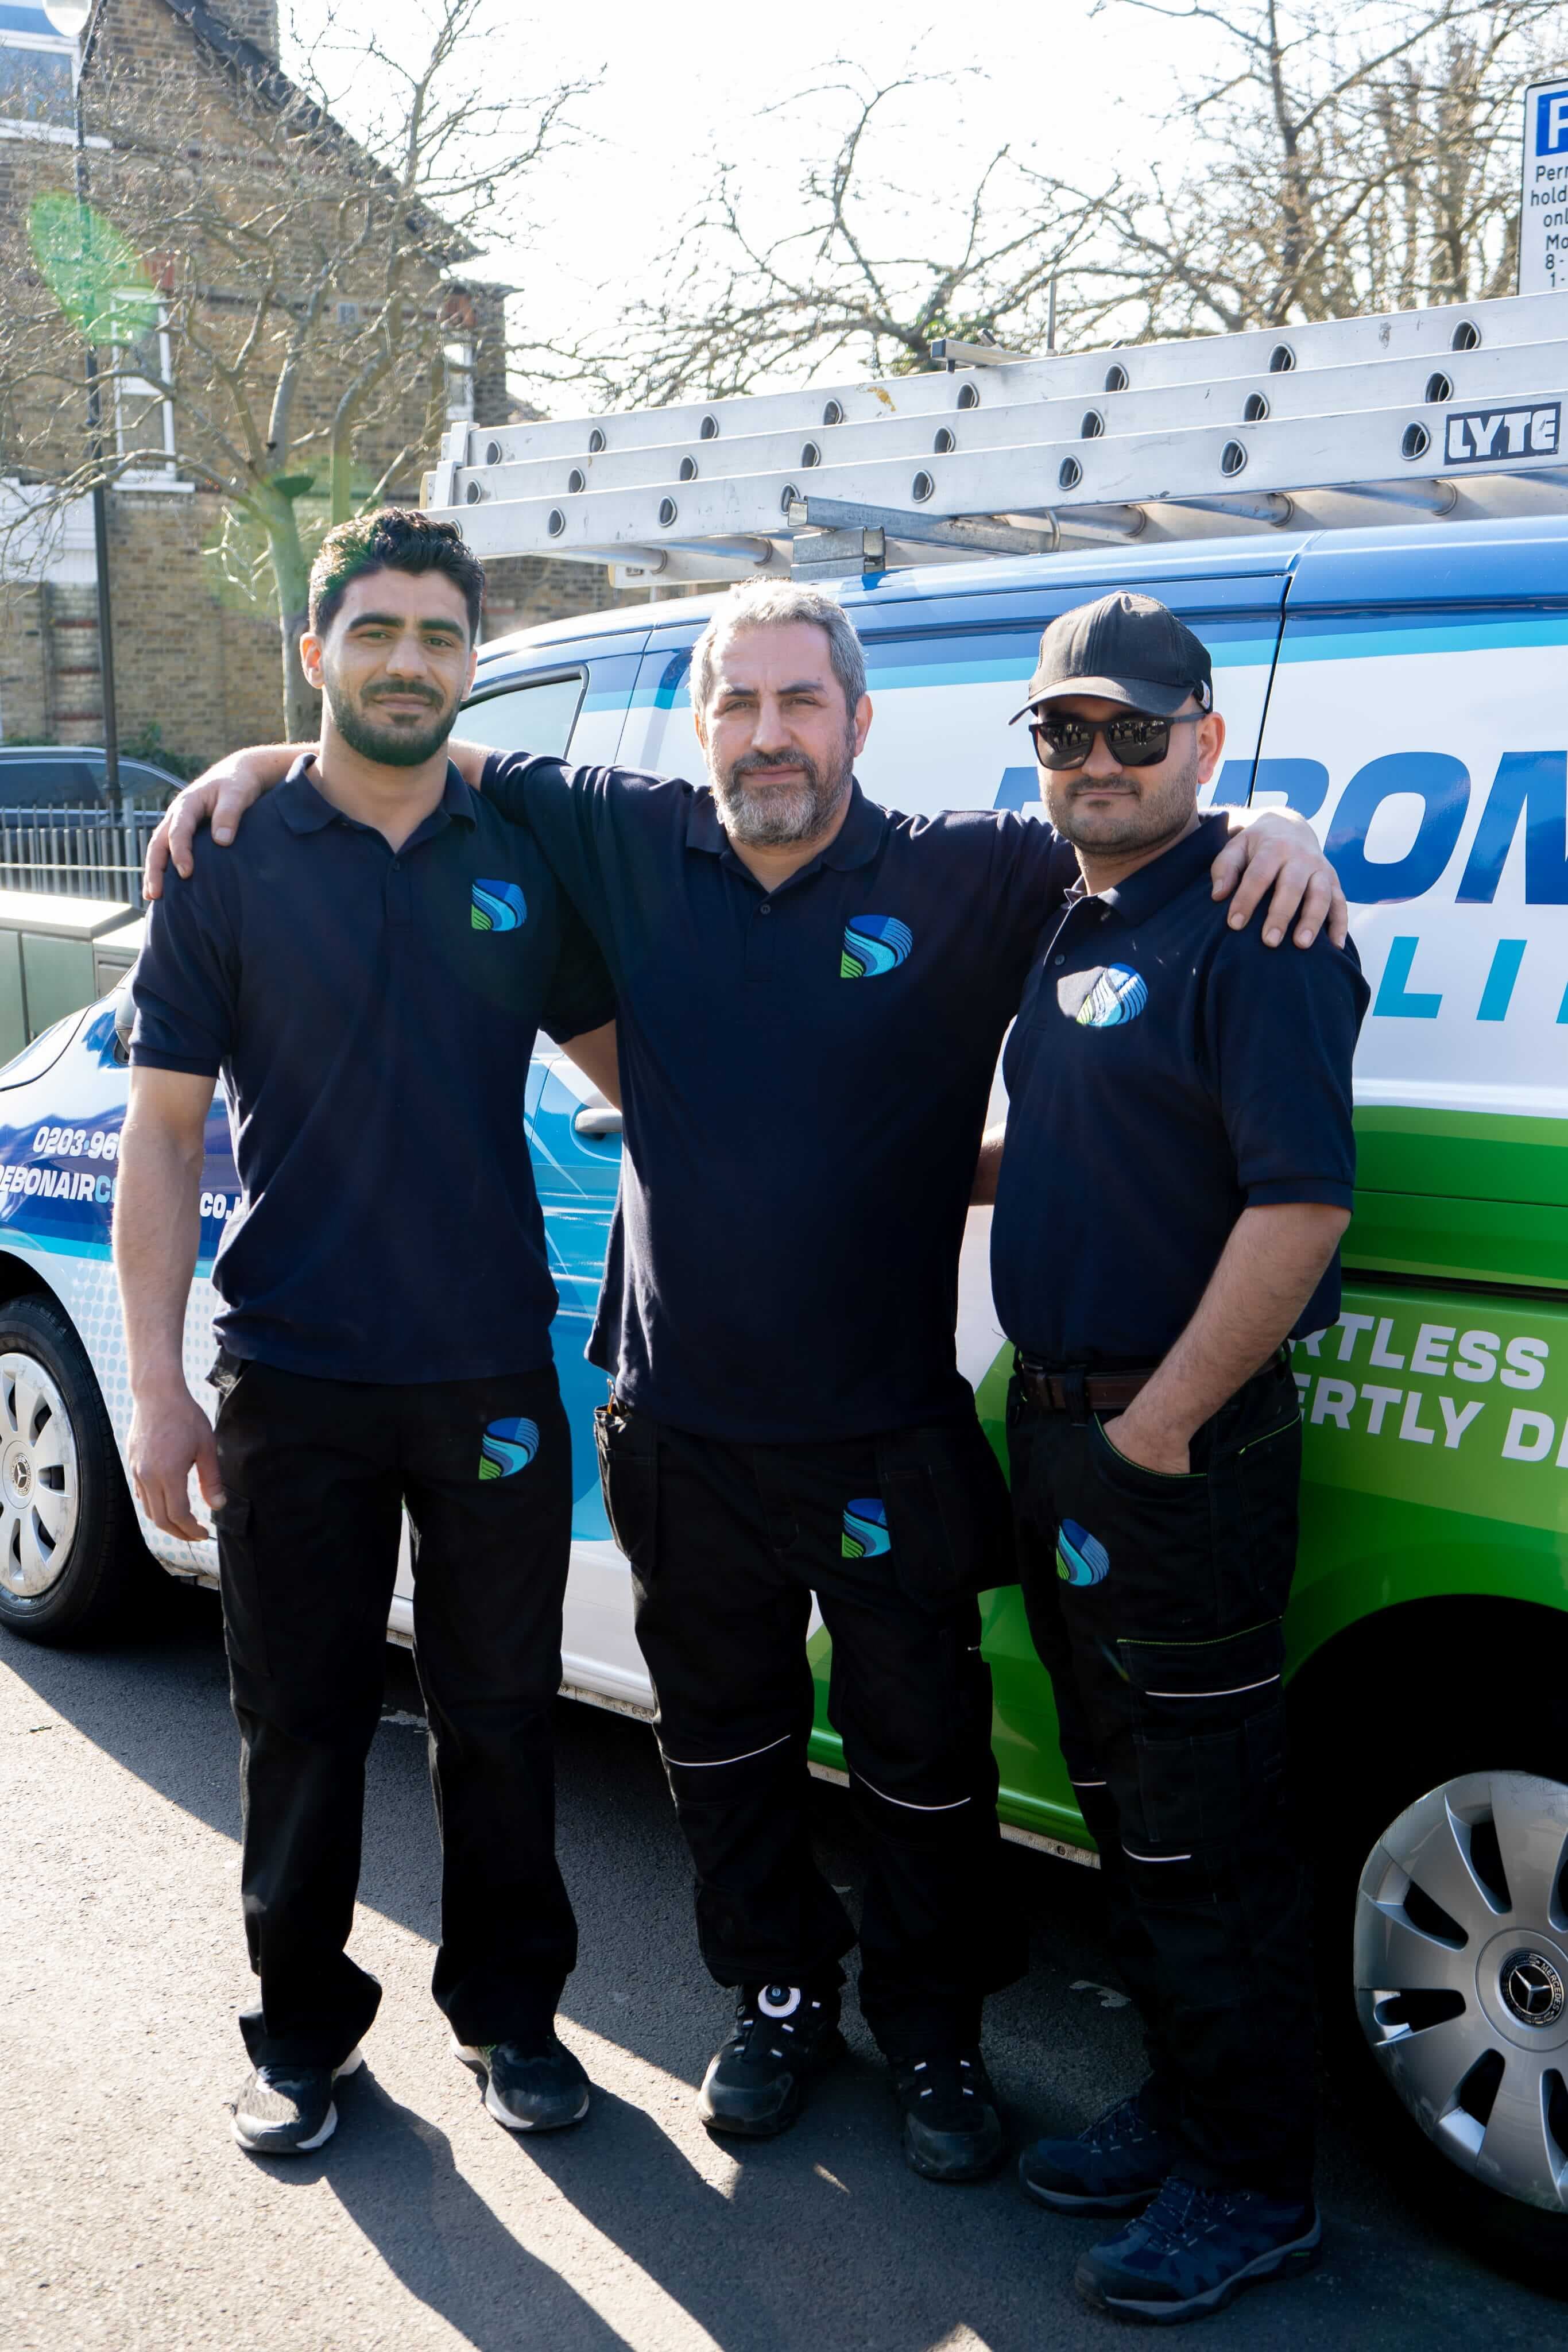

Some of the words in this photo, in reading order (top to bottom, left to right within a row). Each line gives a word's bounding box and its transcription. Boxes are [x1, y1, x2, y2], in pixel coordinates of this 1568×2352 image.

[1448, 408, 1556, 459] LYTE
[1373, 936, 1568, 1024] LI
[0, 1165, 118, 1204] EBONAIRC
[1501, 1407, 1568, 1469] D
[1540, 1962, 1562, 2012] MERCEDES
